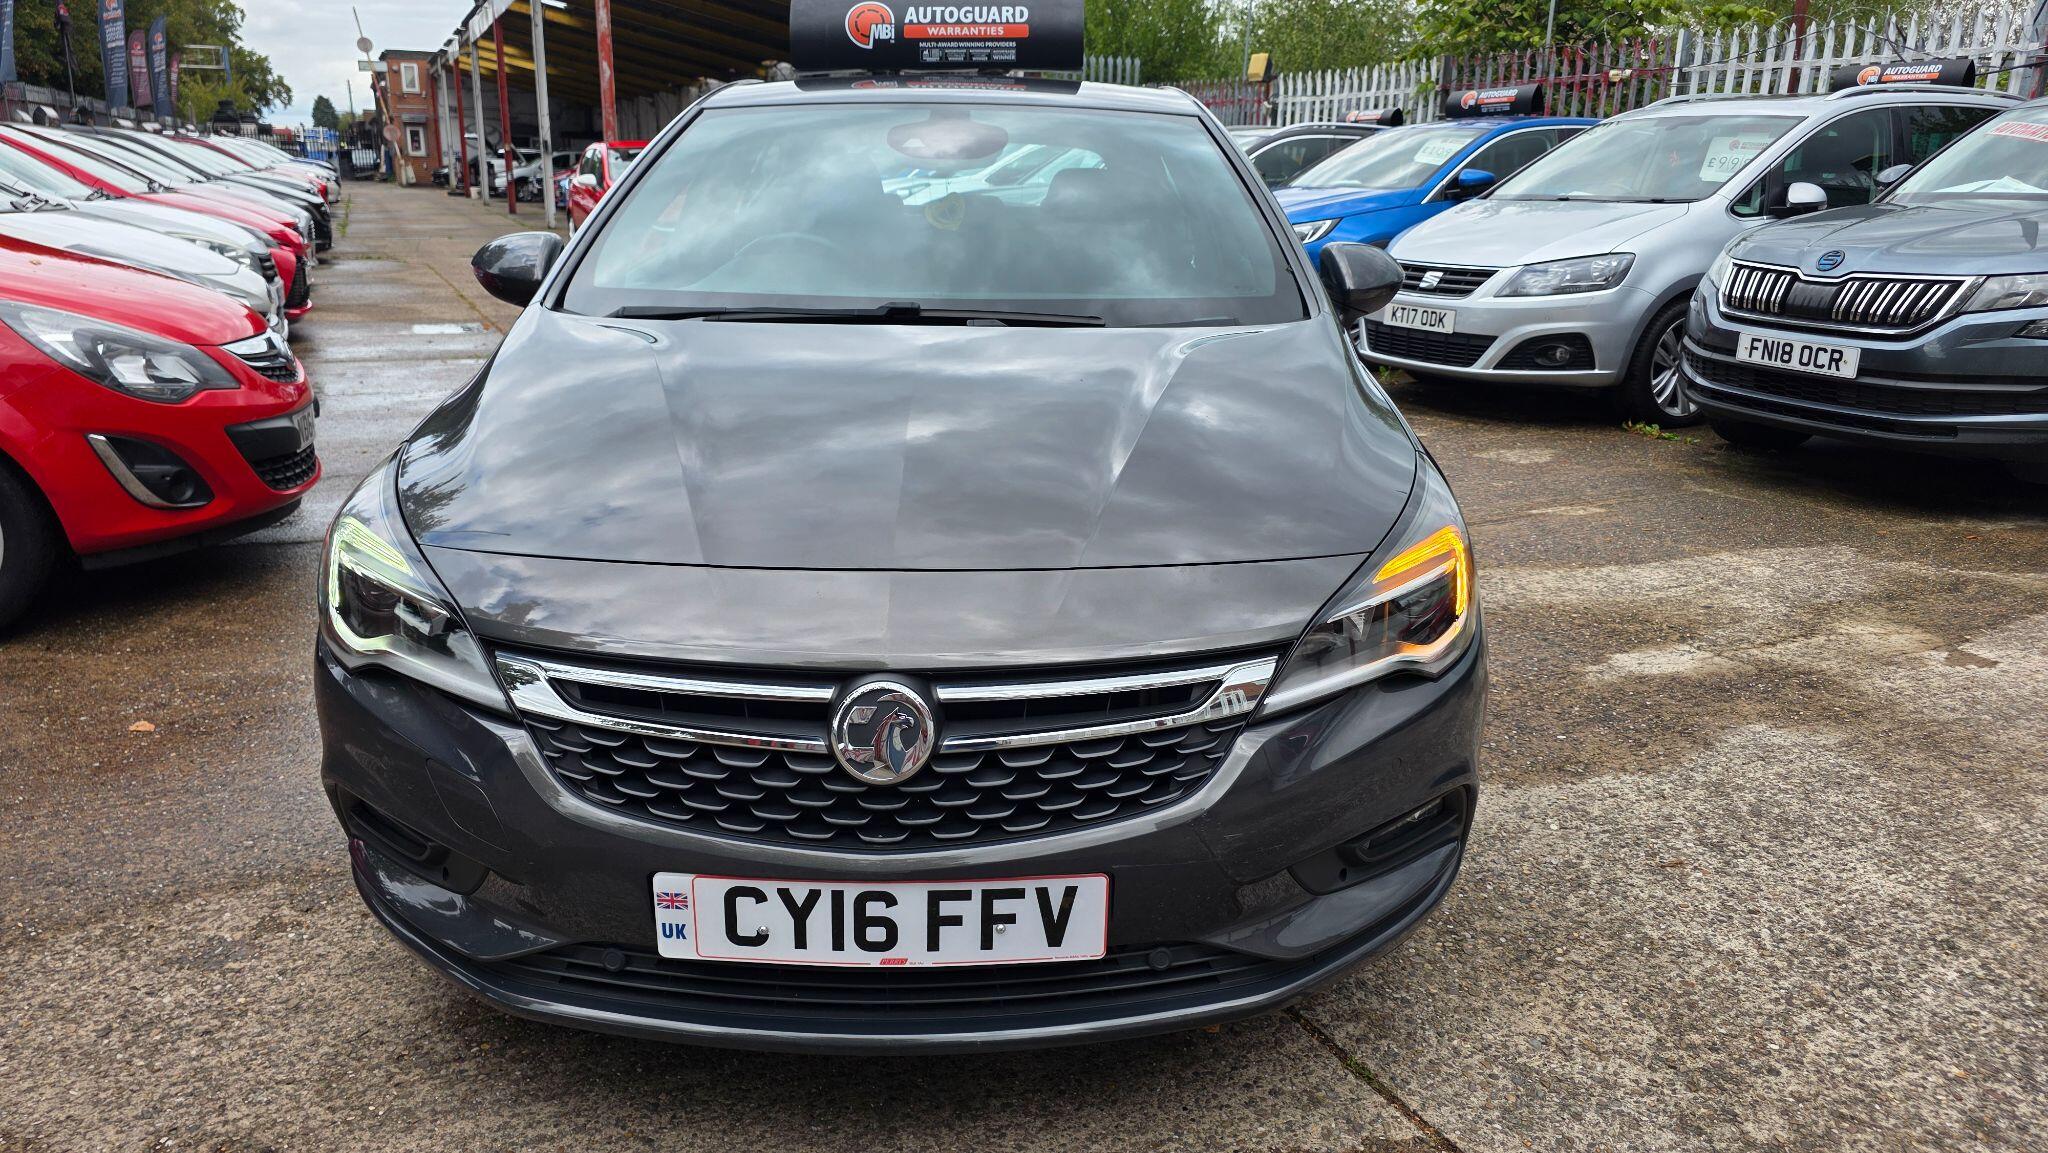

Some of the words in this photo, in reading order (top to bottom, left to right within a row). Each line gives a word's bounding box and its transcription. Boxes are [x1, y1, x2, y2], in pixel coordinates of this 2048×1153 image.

[904, 6, 1029, 23] AUTOGUARD
[927, 27, 1004, 36] WARRANTIES
[1884, 64, 1942, 75] AUTOGUARD
[1479, 89, 1518, 98] AUTOGUARD
[1391, 305, 1418, 325] KT17
[1420, 310, 1447, 329] ODK
[1748, 337, 1794, 364] FN18
[1798, 344, 1844, 372] OCR
[723, 885, 899, 953] CY16
[926, 885, 1079, 953] FFV
[661, 922, 687, 940] UK
